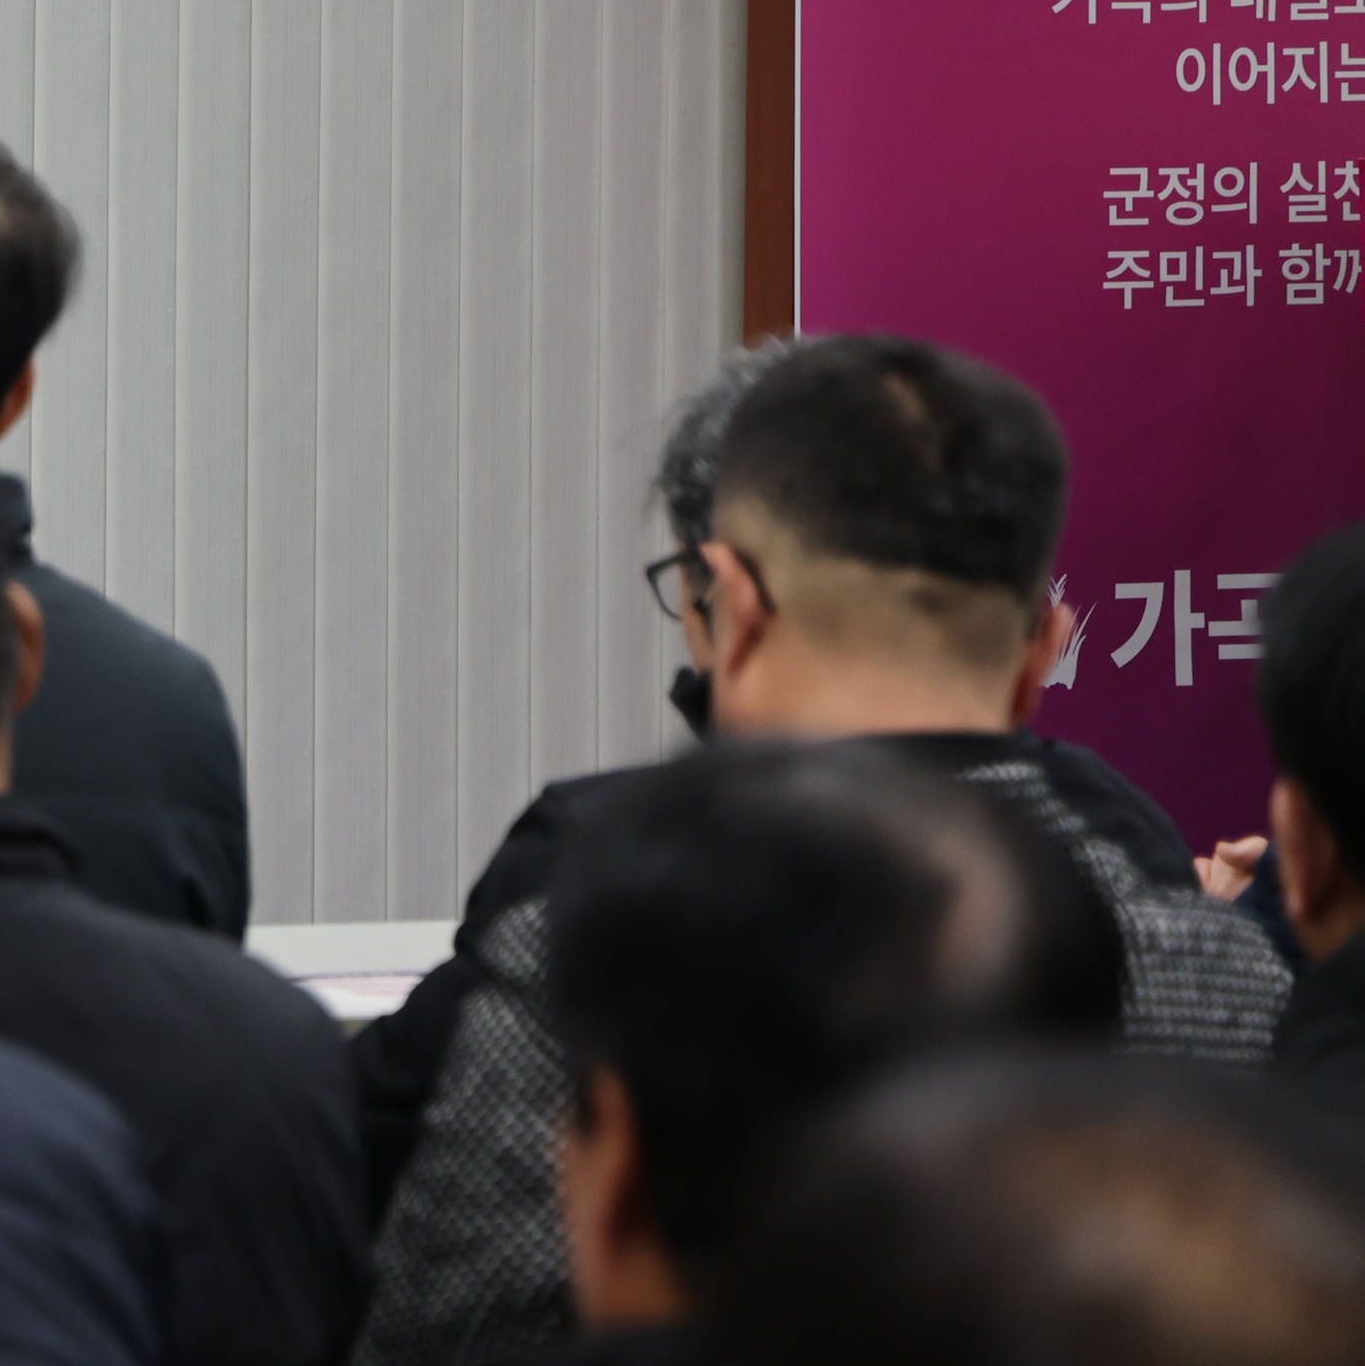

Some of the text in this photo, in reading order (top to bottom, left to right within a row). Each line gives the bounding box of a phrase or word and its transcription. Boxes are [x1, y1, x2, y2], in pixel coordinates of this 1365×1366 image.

[1175, 41, 1365, 106] 이어지는
[1102, 161, 1258, 226] 군정의
[1102, 244, 1263, 310] 주민과
